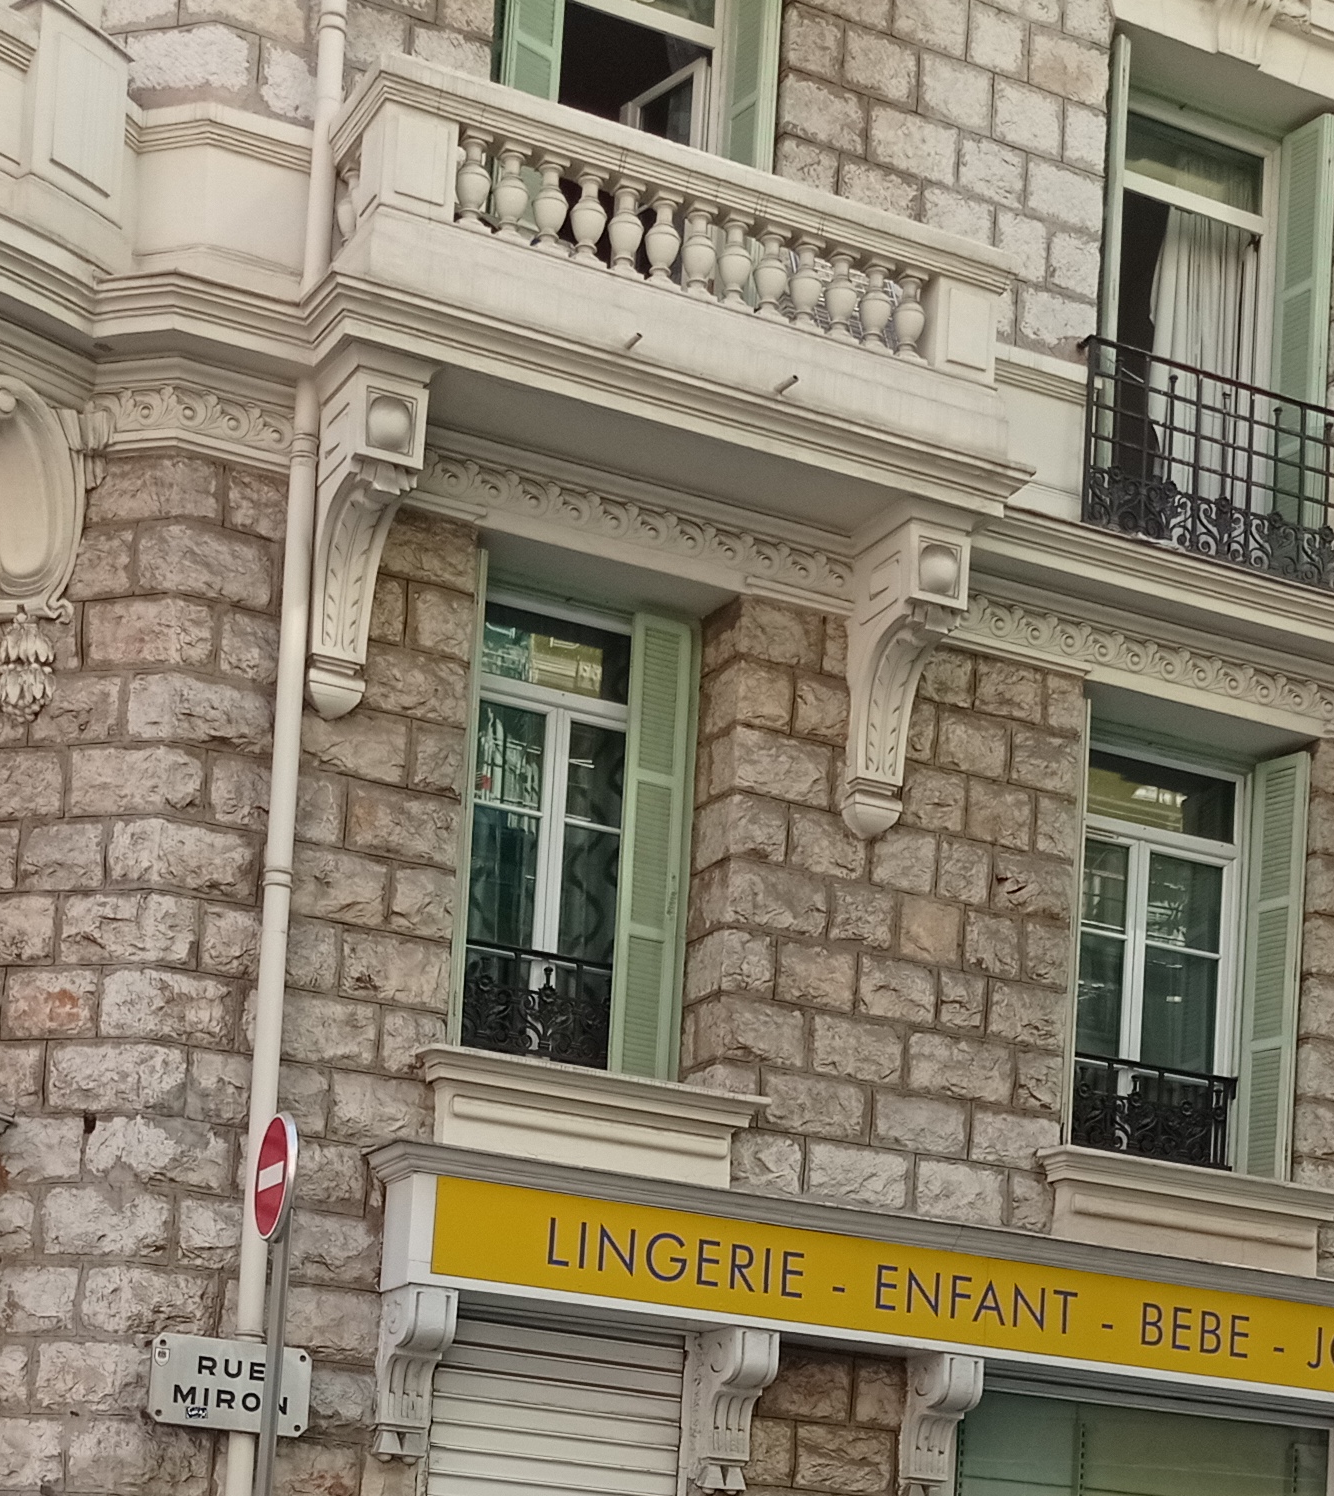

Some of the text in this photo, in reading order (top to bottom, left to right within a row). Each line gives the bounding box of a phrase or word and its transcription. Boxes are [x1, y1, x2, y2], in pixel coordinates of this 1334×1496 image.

[546, 1216, 806, 1299] LINGERIE
[874, 1263, 1079, 1335] ENFANT
[1140, 1301, 1251, 1359] BEBE
[197, 1355, 266, 1382] RUE
